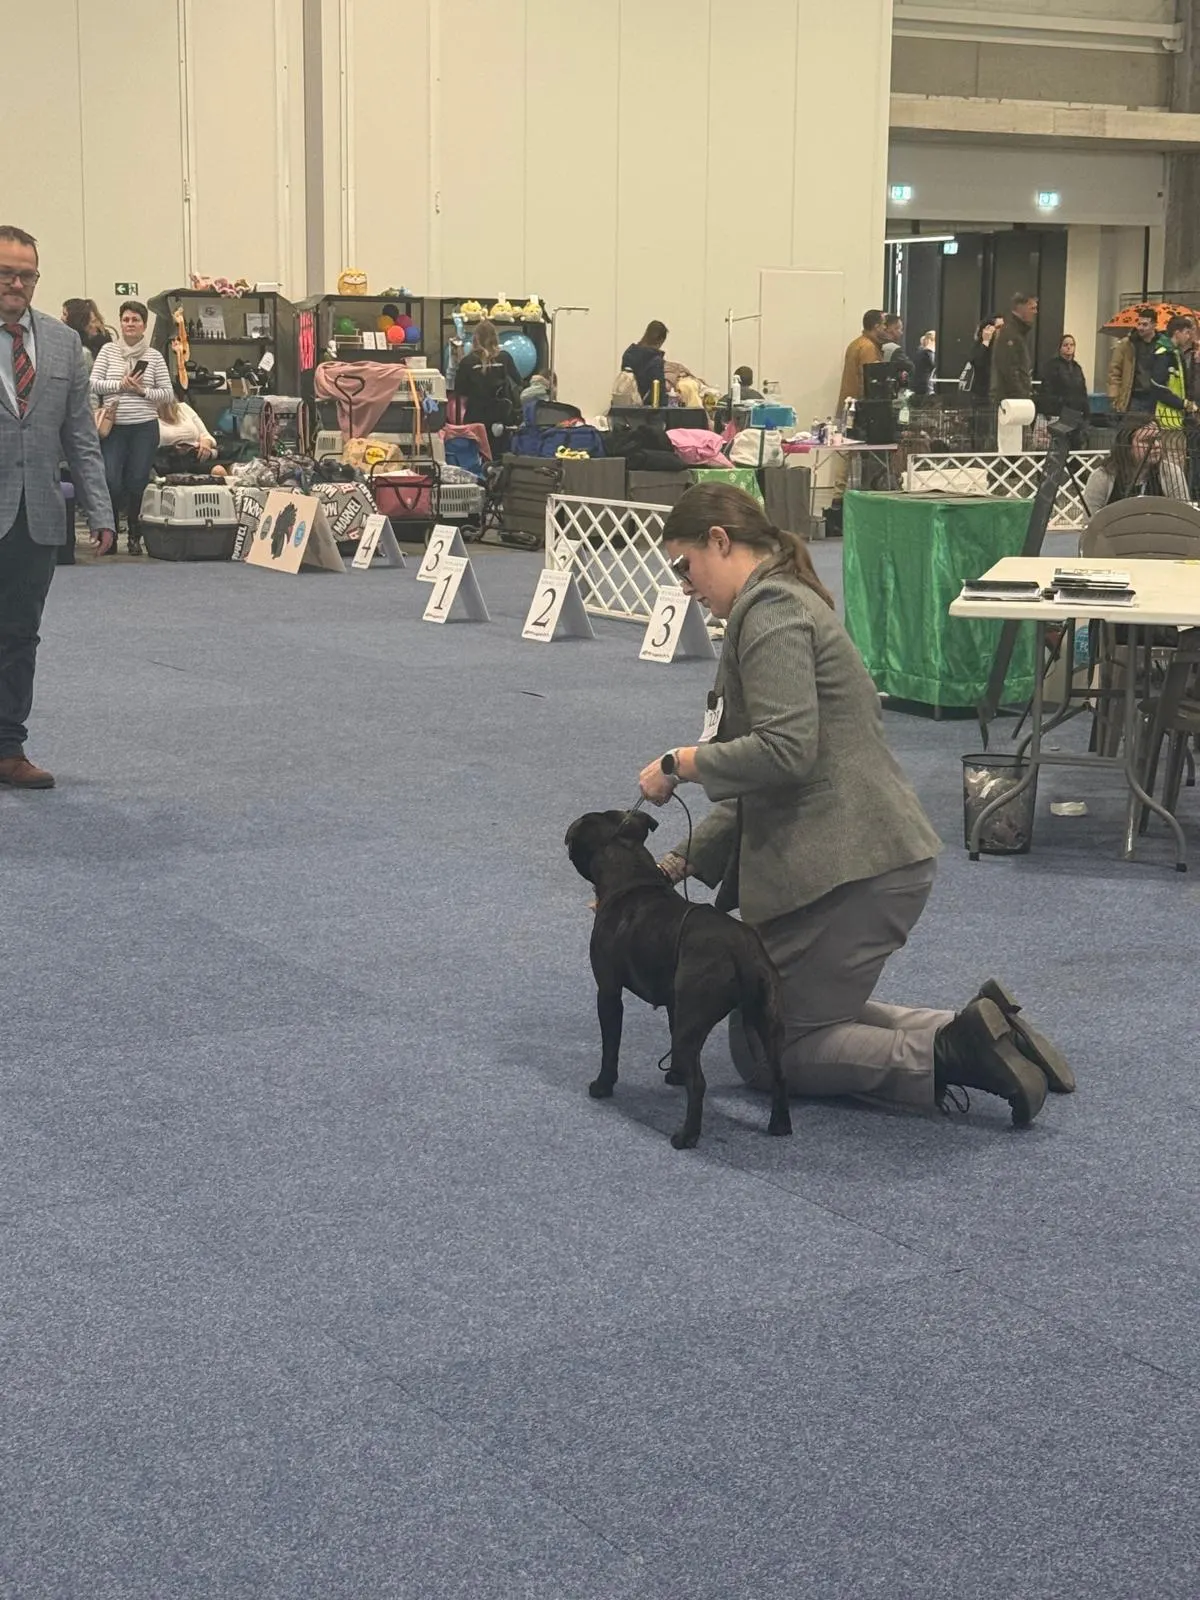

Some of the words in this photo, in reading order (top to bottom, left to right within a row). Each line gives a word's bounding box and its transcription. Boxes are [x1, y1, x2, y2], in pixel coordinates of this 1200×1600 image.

[333, 499, 362, 536] MARVEL
[362, 528, 377, 559] 4
[426, 540, 444, 572] 3
[434, 574, 453, 610] 1
[531, 588, 556, 628] 2
[651, 605, 676, 647] 3
